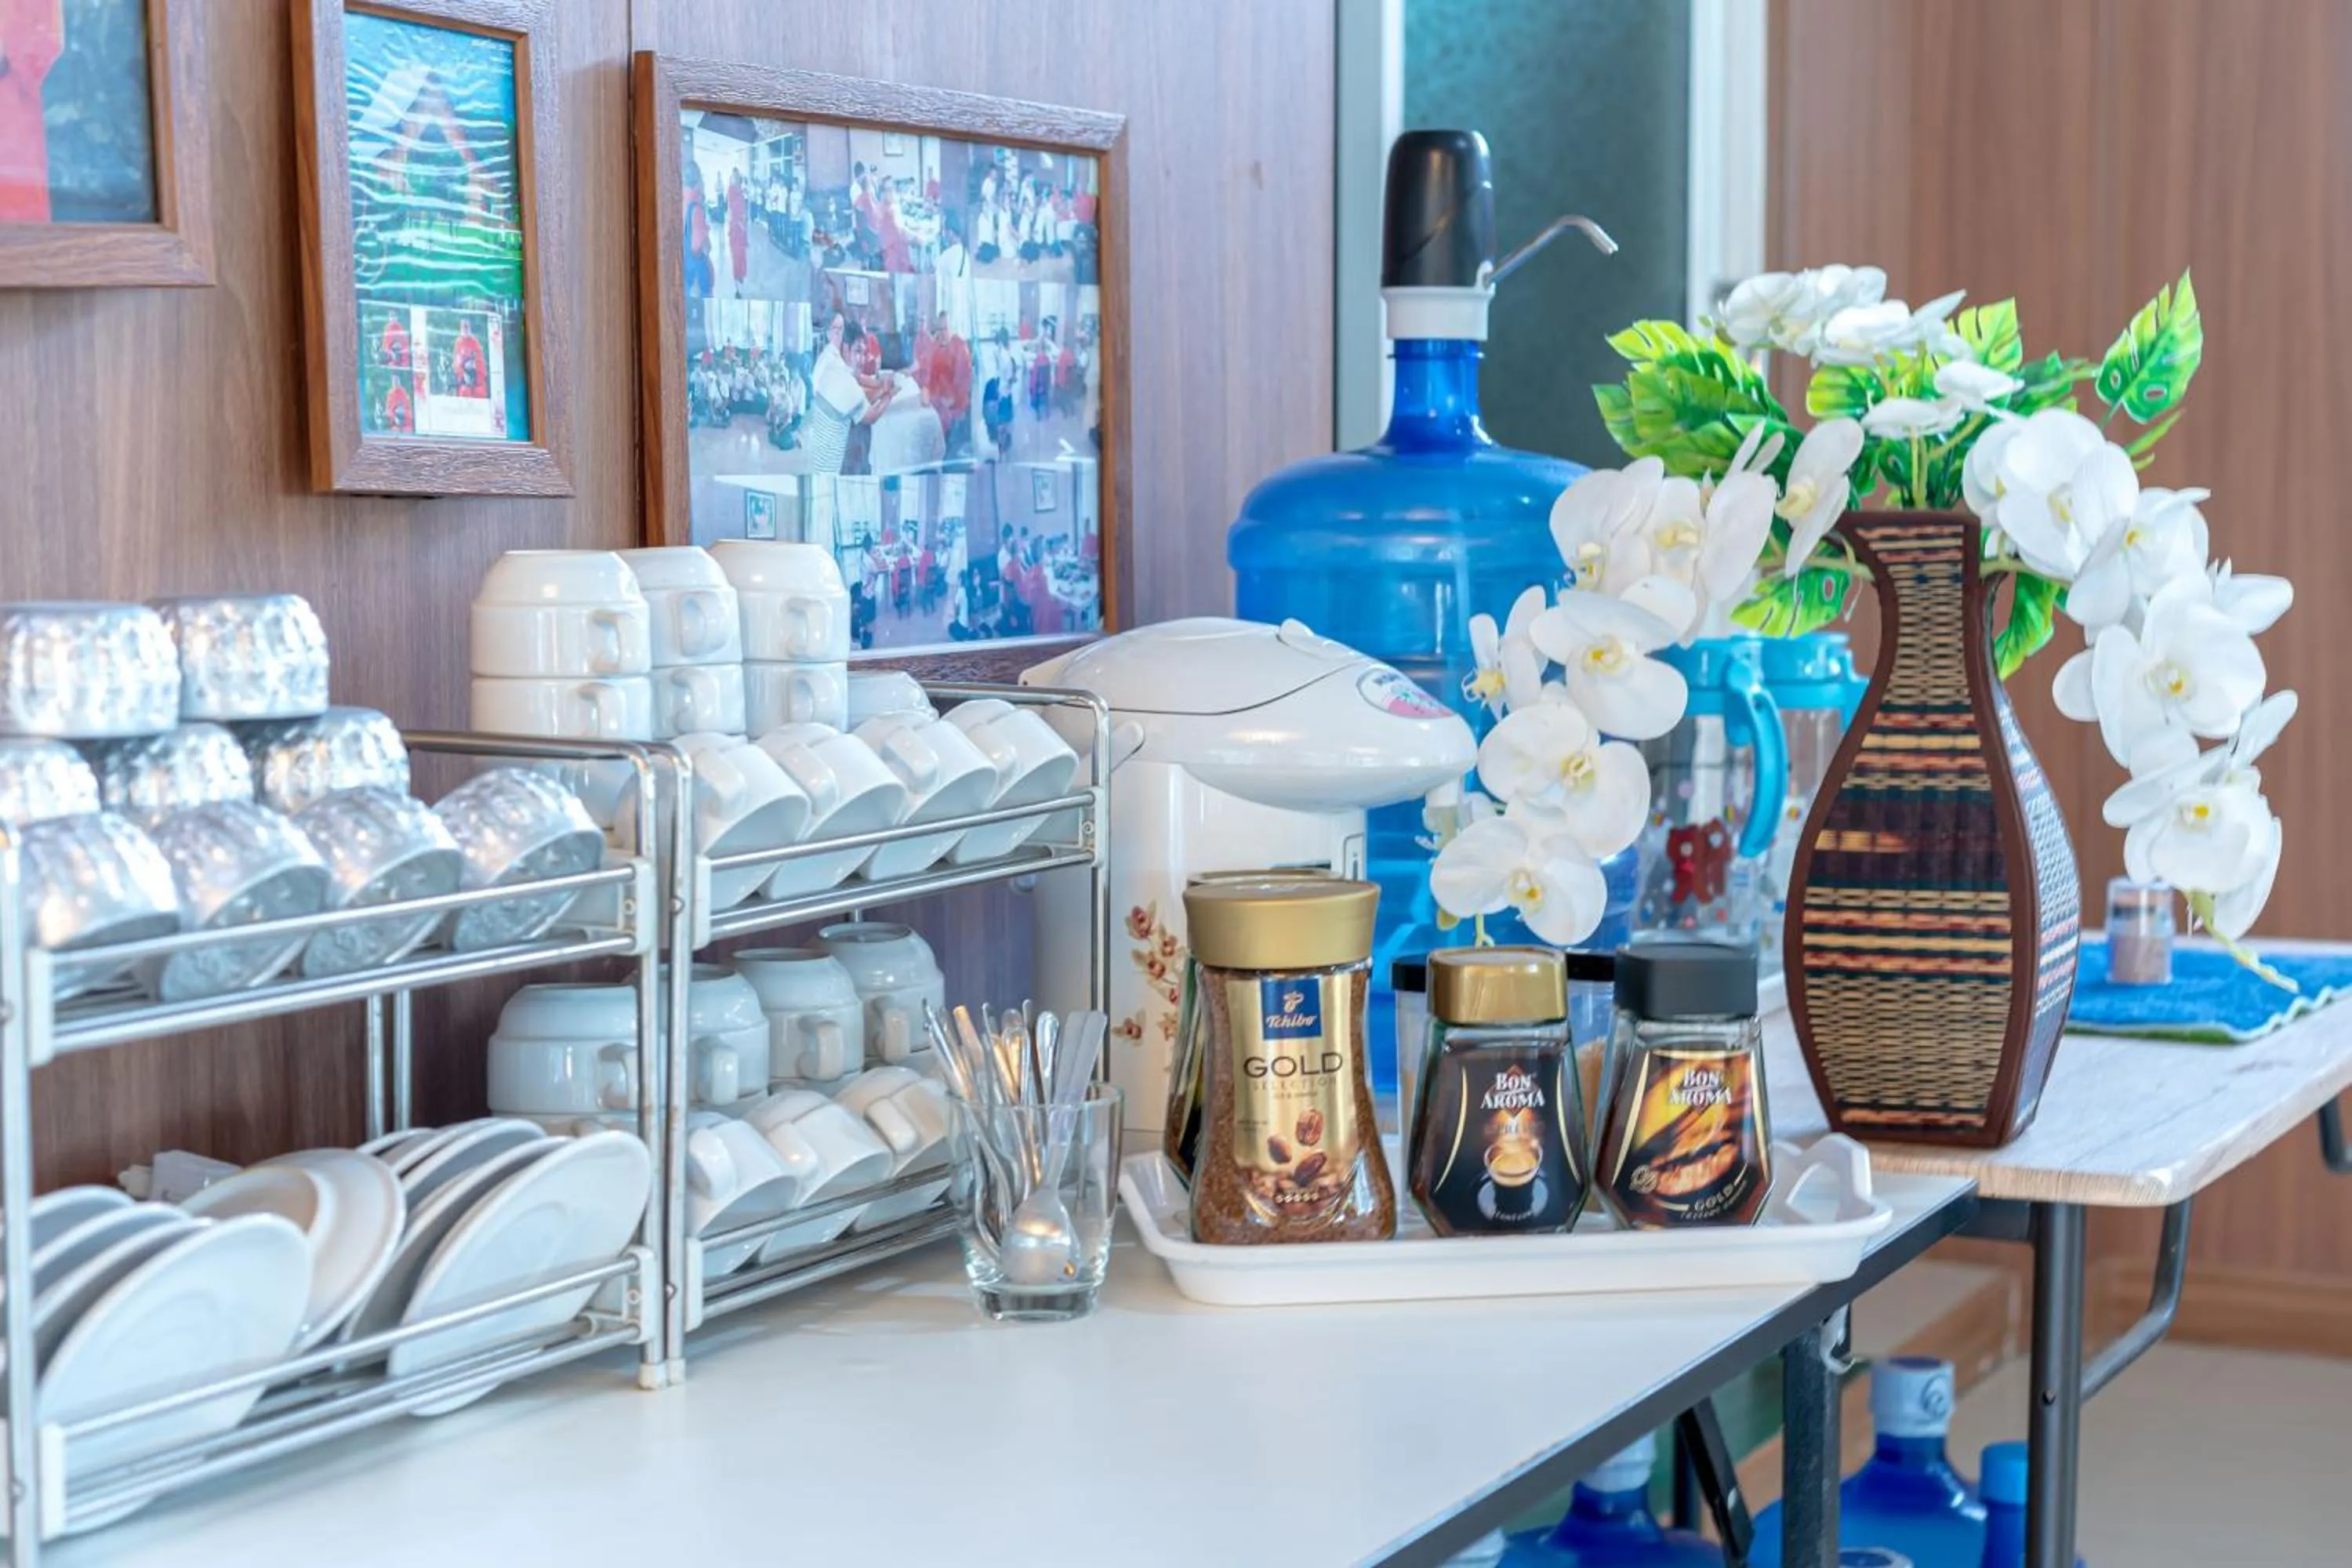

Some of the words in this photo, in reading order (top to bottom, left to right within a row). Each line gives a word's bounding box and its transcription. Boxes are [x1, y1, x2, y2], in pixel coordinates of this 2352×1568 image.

[1265, 1013, 1316, 1028] Tchibo
[1243, 1052, 1343, 1078] GOLD
[1496, 1072, 1531, 1091] BON
[1683, 1068, 1719, 1087] BON
[1479, 1088, 1545, 1109] AROMA
[1670, 1086, 1732, 1106] AROMA
